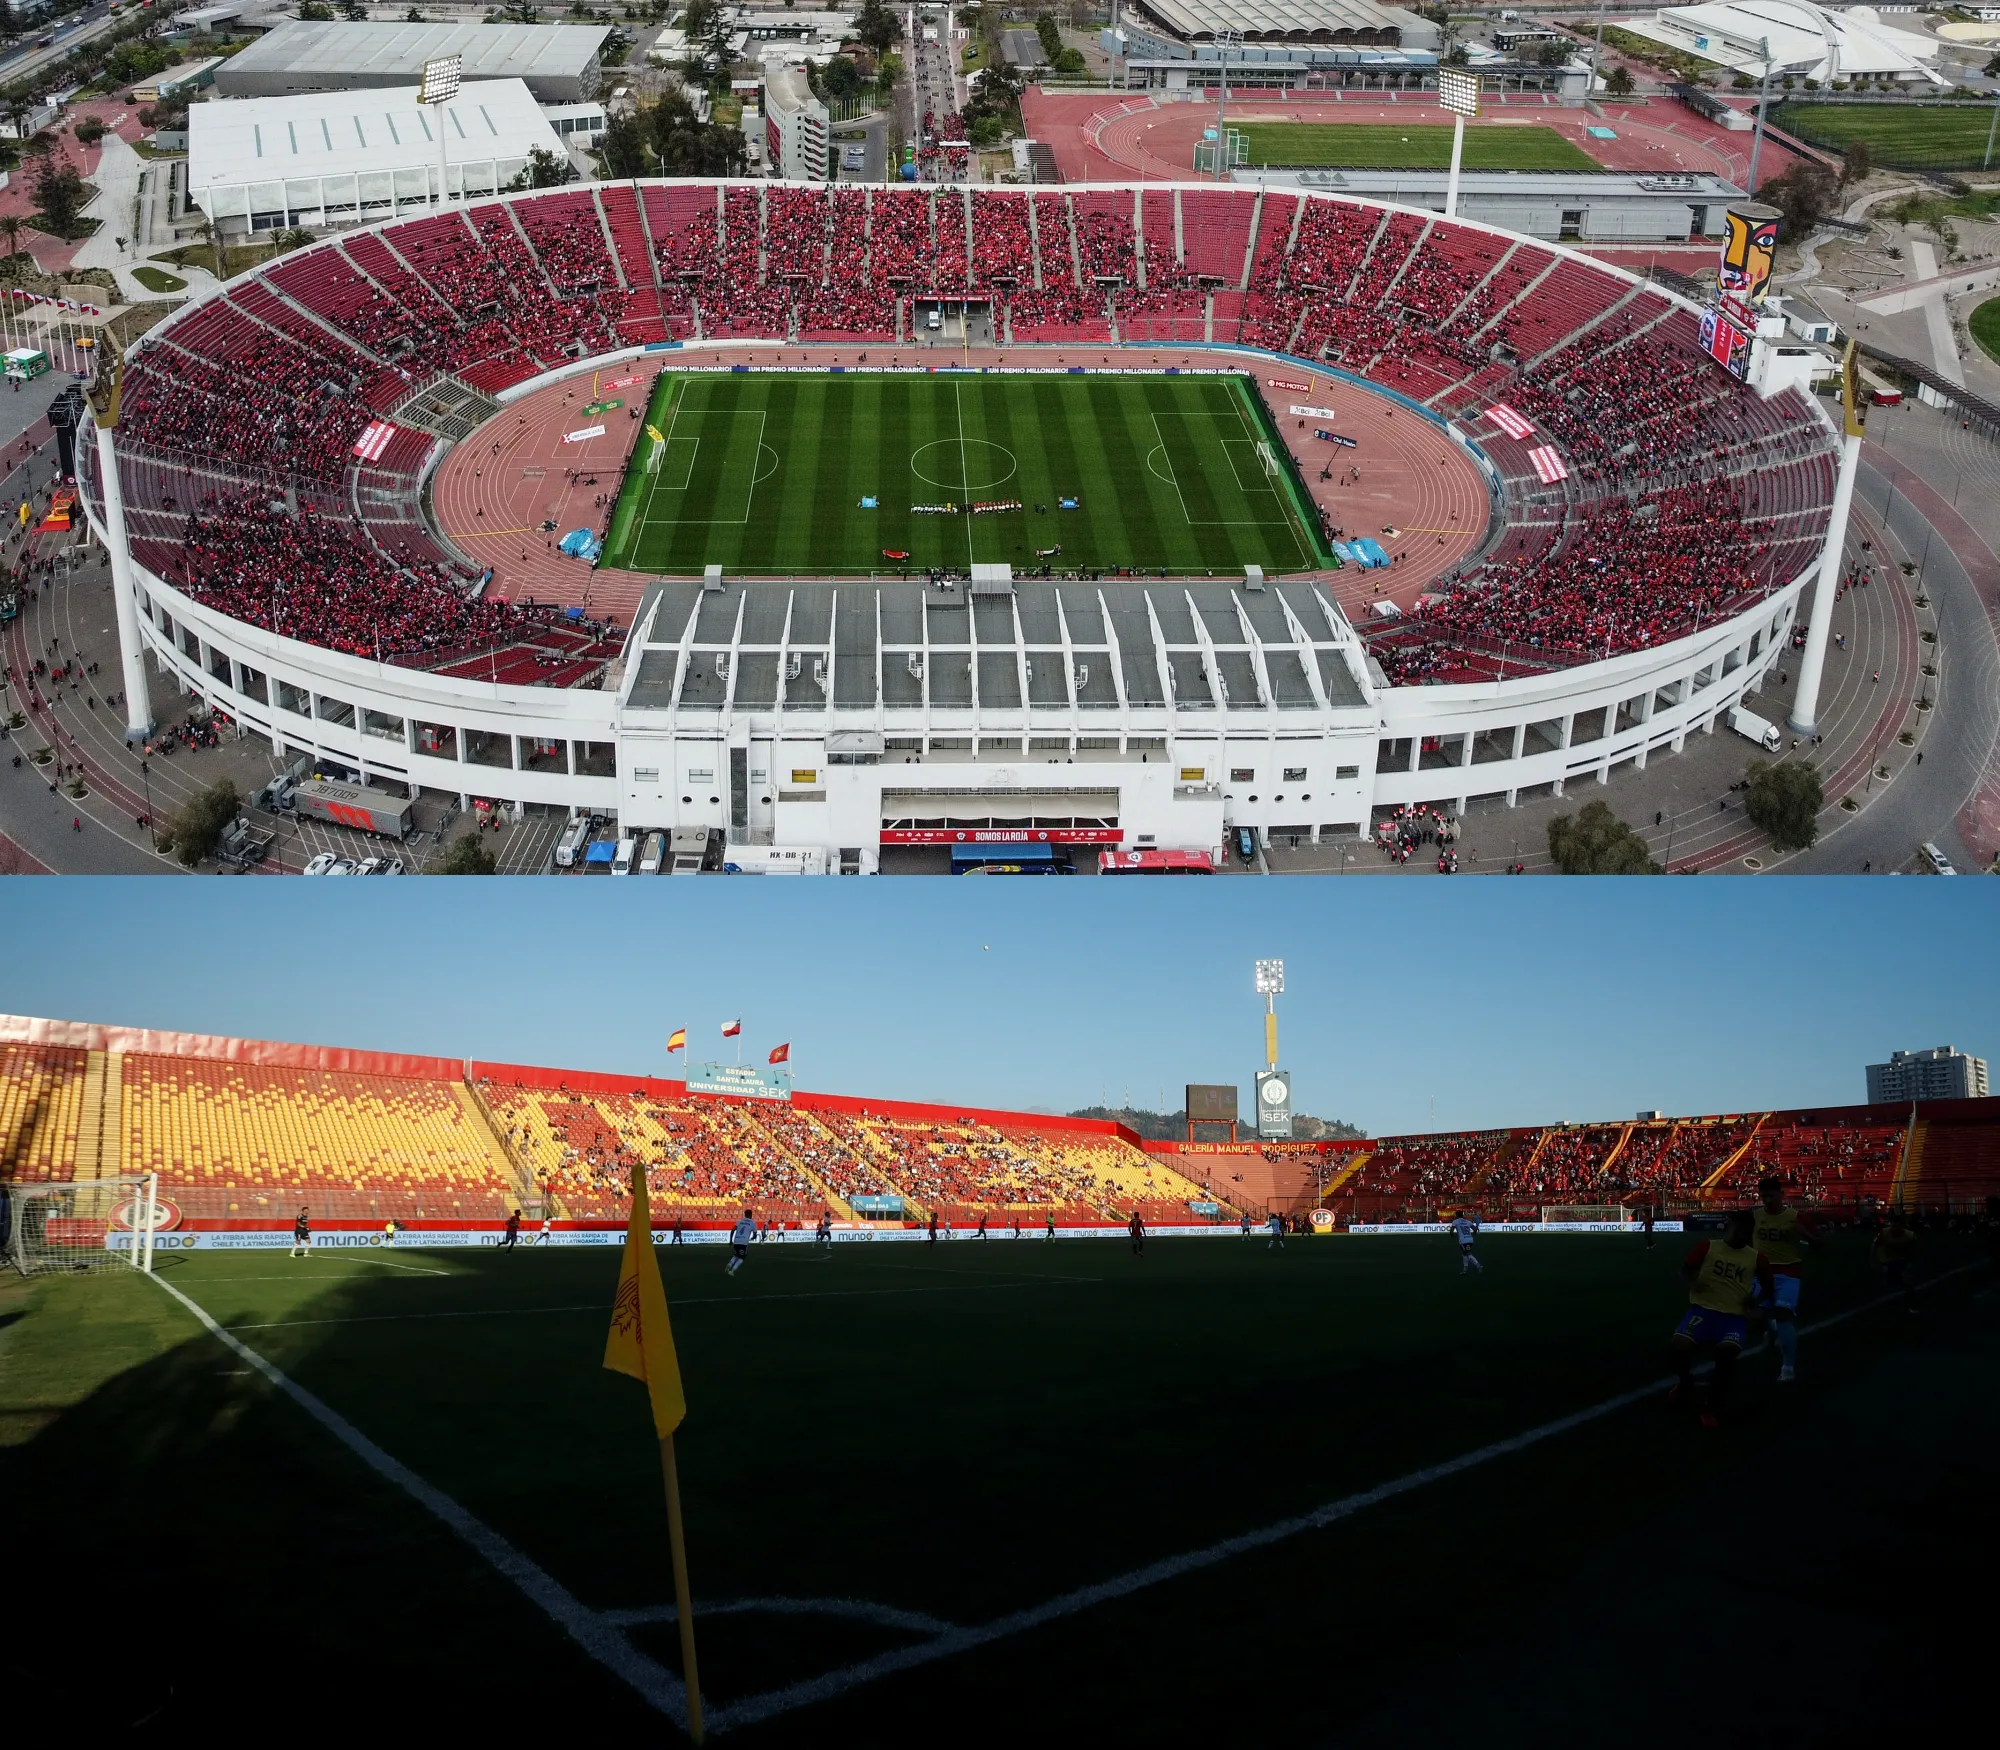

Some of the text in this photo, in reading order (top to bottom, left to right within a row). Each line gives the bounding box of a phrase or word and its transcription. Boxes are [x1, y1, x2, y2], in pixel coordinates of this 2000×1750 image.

[1286, 382, 1309, 391] MOTOR
[357, 438, 368, 449] NO
[311, 784, 359, 801] JB7009
[975, 831, 1028, 841] SOMOS LA ROJA
[726, 1068, 756, 1076] ESTADIO
[716, 1076, 740, 1084] SANTA
[690, 1082, 788, 1098] UNIVERSIDAD SEK
[1265, 1113, 1289, 1122] SEK
[1178, 1143, 1214, 1152] GALERÍA
[1218, 1144, 1257, 1153] MANUEL
[1316, 1212, 1328, 1223] PF
[1712, 1260, 1745, 1282] SEK
